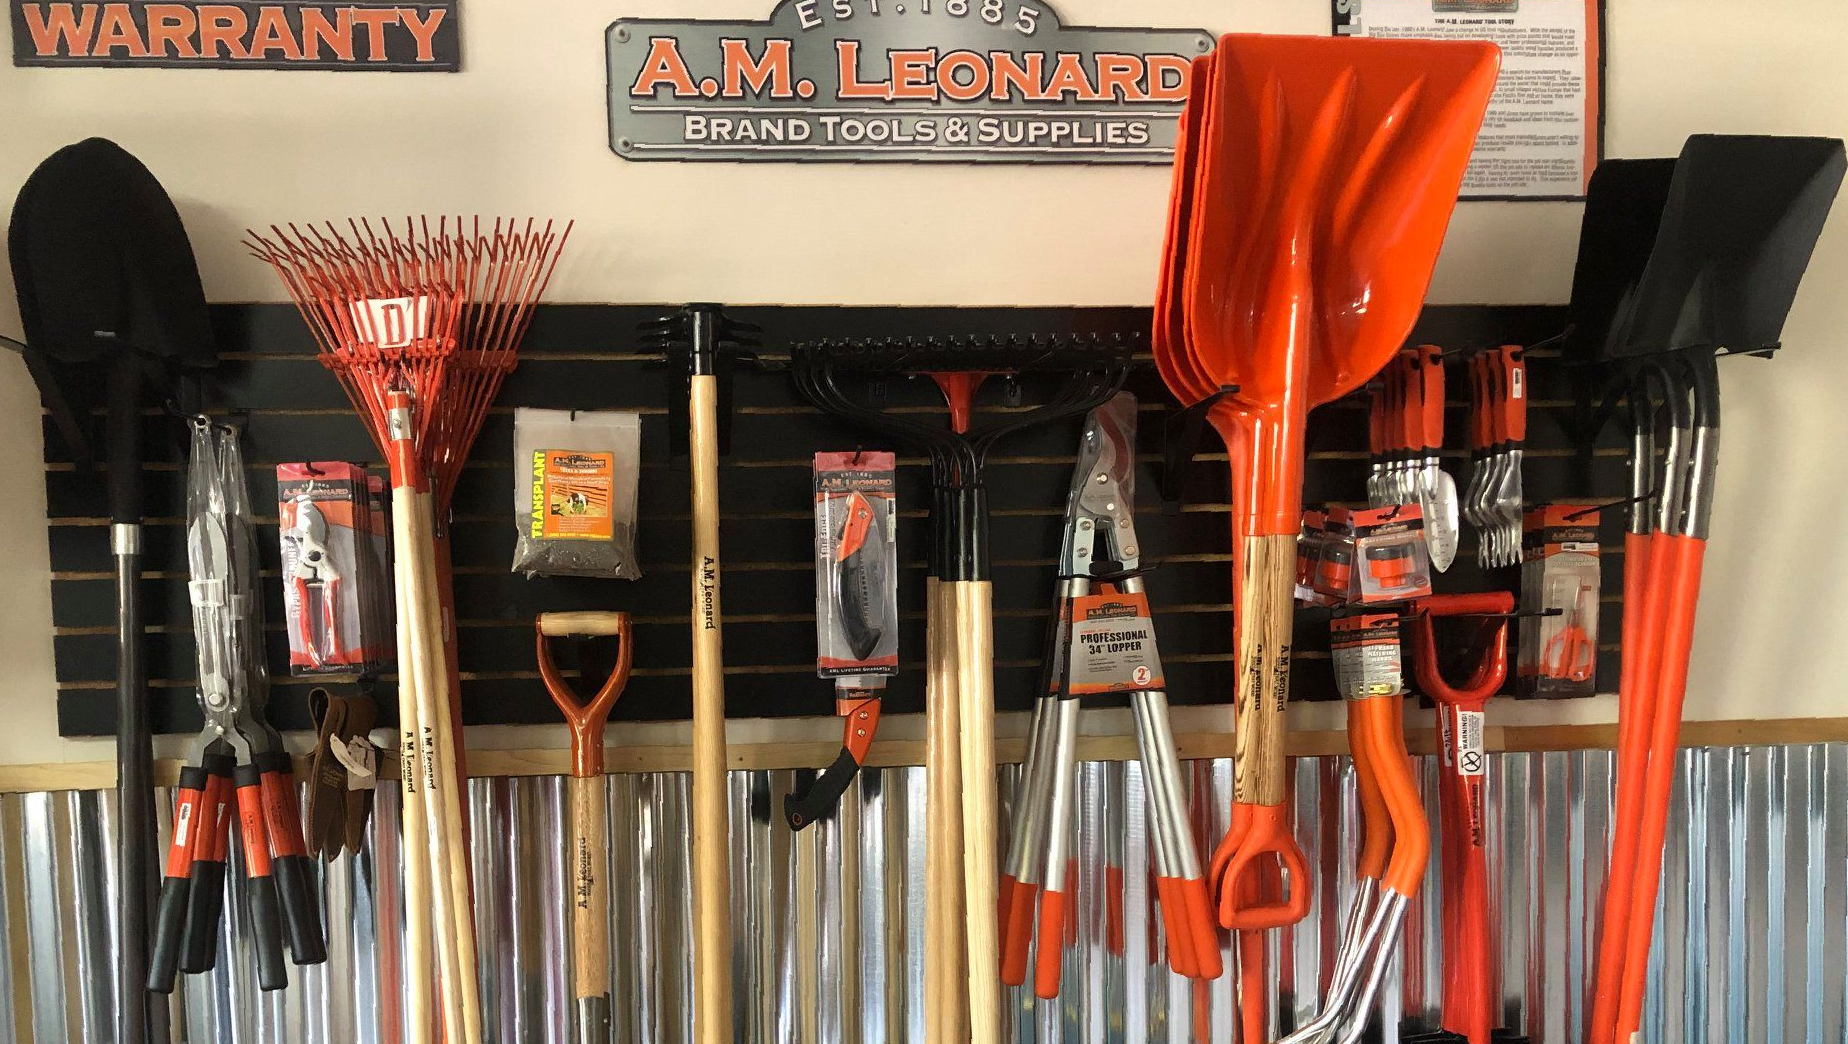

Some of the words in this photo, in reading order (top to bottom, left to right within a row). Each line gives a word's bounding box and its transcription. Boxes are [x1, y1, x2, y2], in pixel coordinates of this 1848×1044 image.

[22, 4, 447, 62] WARRANTY
[631, 37, 816, 98] A.M.
[836, 41, 1191, 102] LEONARD
[684, 115, 811, 142] BRAND
[819, 115, 936, 143] TOOLS
[944, 117, 969, 142] &
[977, 116, 1149, 144] SUPPLIES
[532, 451, 545, 539] TRANSPLANT
[704, 585, 717, 630] Leonard
[1080, 630, 1148, 644] PROFESSIONAL
[1107, 641, 1142, 654] LOPPER
[1137, 668, 1146, 681] 2
